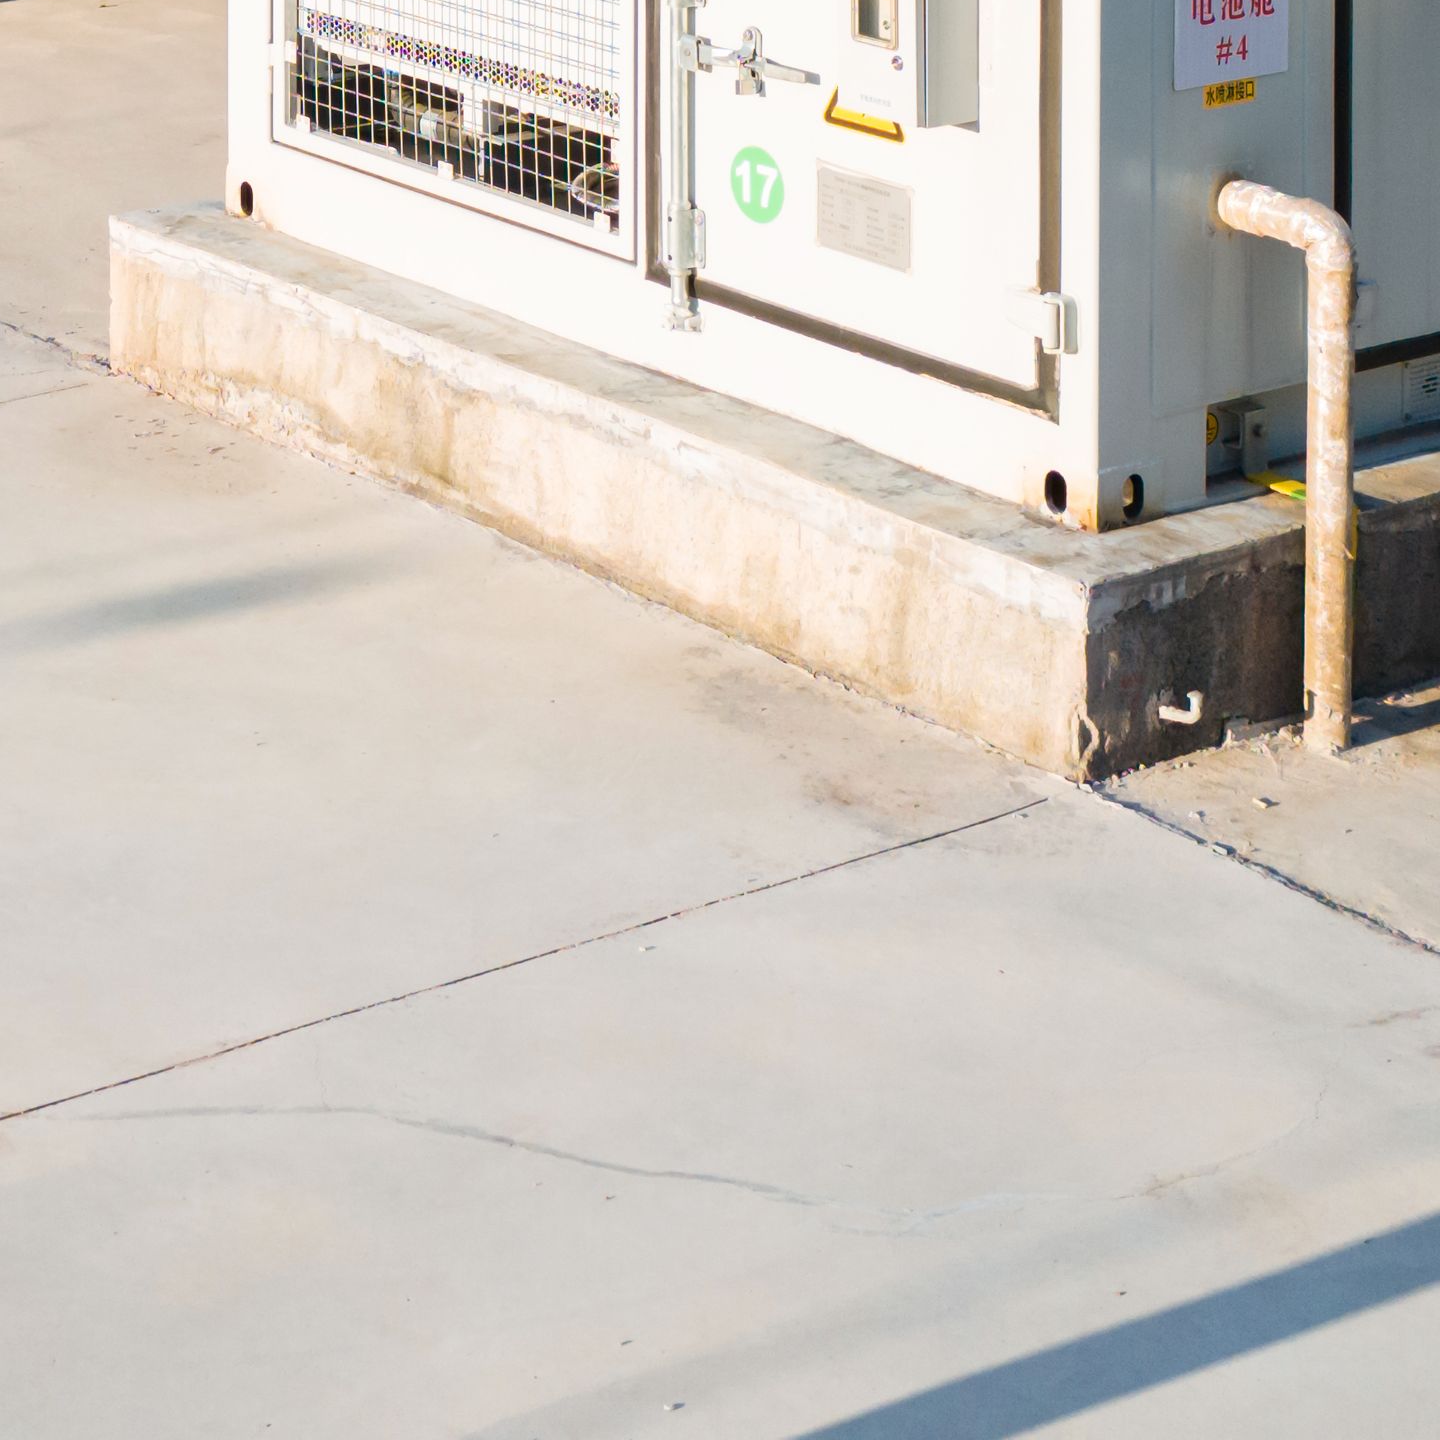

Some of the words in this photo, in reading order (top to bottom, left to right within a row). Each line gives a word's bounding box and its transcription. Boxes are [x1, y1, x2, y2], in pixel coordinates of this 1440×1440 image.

[1216, 34, 1249, 66] #4
[1205, 80, 1255, 106] 水喷淋接口
[735, 159, 778, 209] 17
